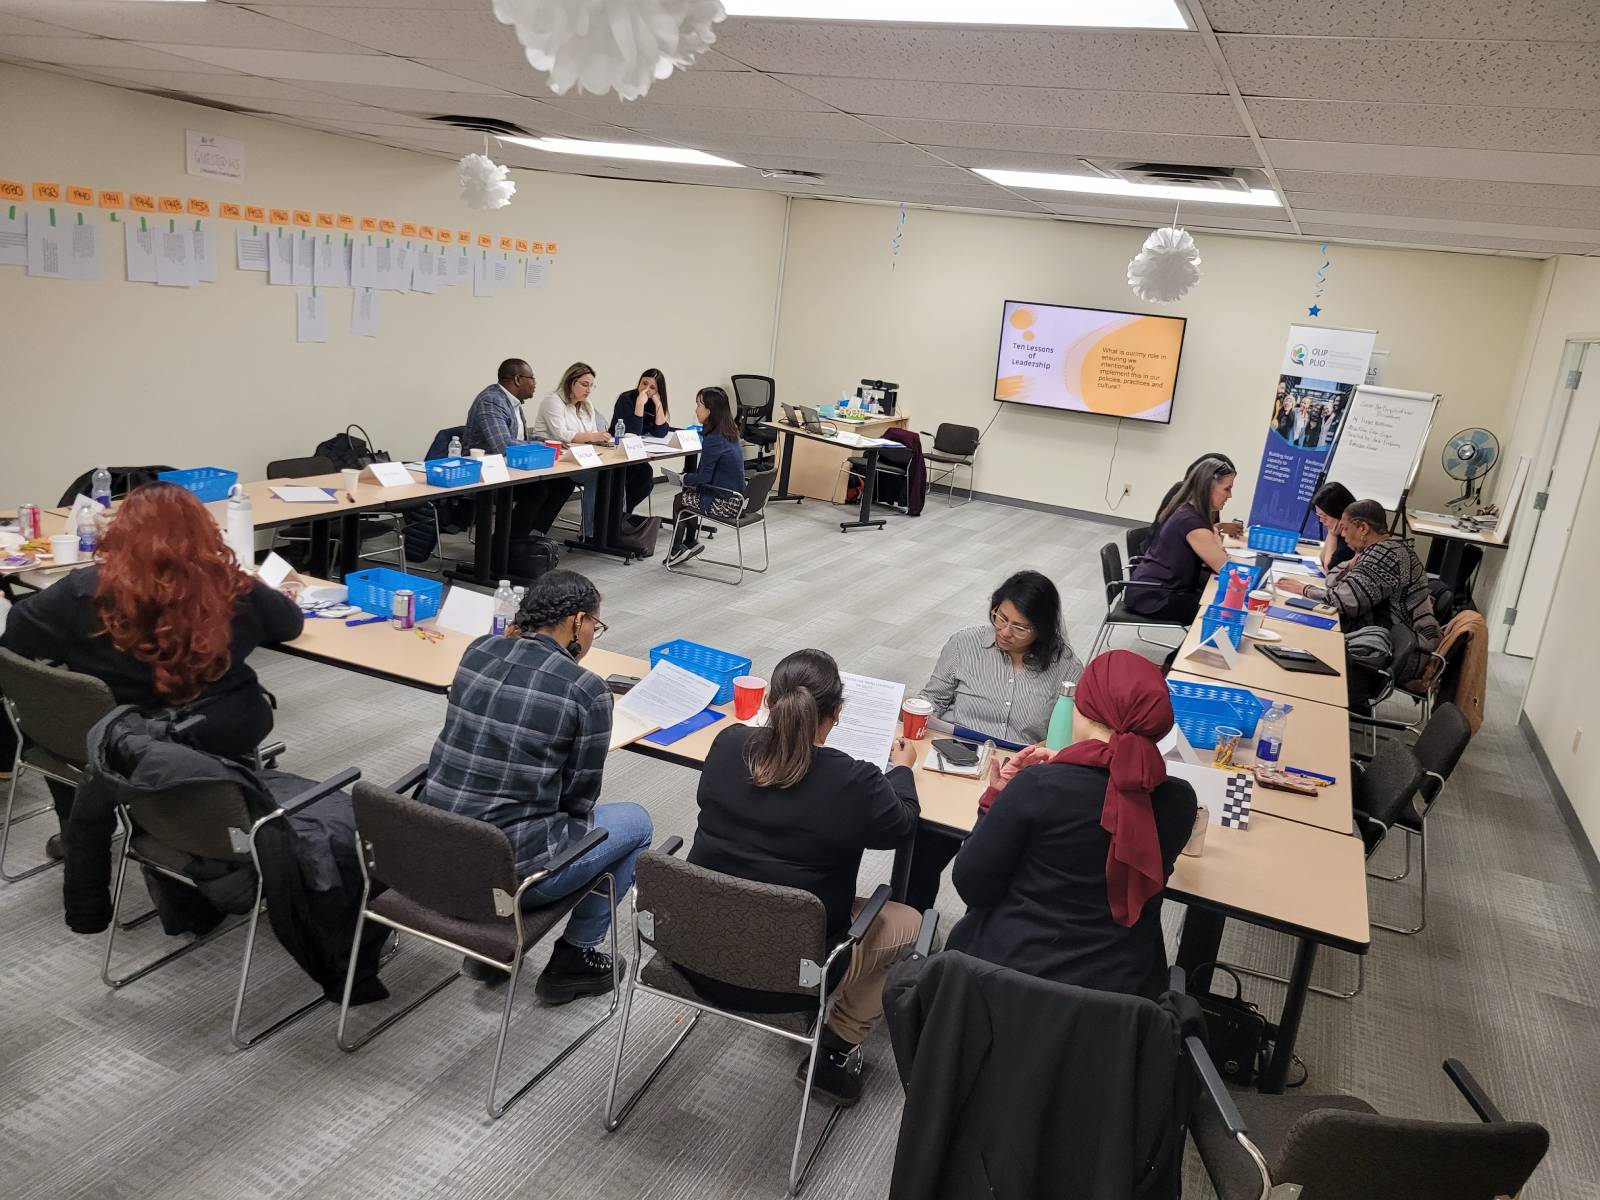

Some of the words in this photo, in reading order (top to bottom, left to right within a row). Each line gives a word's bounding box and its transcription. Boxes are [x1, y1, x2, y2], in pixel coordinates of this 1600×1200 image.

[1012, 342, 1026, 351] Ten
[1026, 344, 1055, 354] Lessons
[1311, 347, 1329, 357] OLIP
[1028, 352, 1037, 360] of
[1101, 355, 1127, 364] ensuring
[1011, 358, 1051, 370] Leadership
[1100, 362, 1136, 372] intentionally
[1309, 358, 1326, 368] PLIO
[1099, 369, 1130, 377] implement
[1123, 379, 1150, 387] practices
[1151, 381, 1164, 389] and
